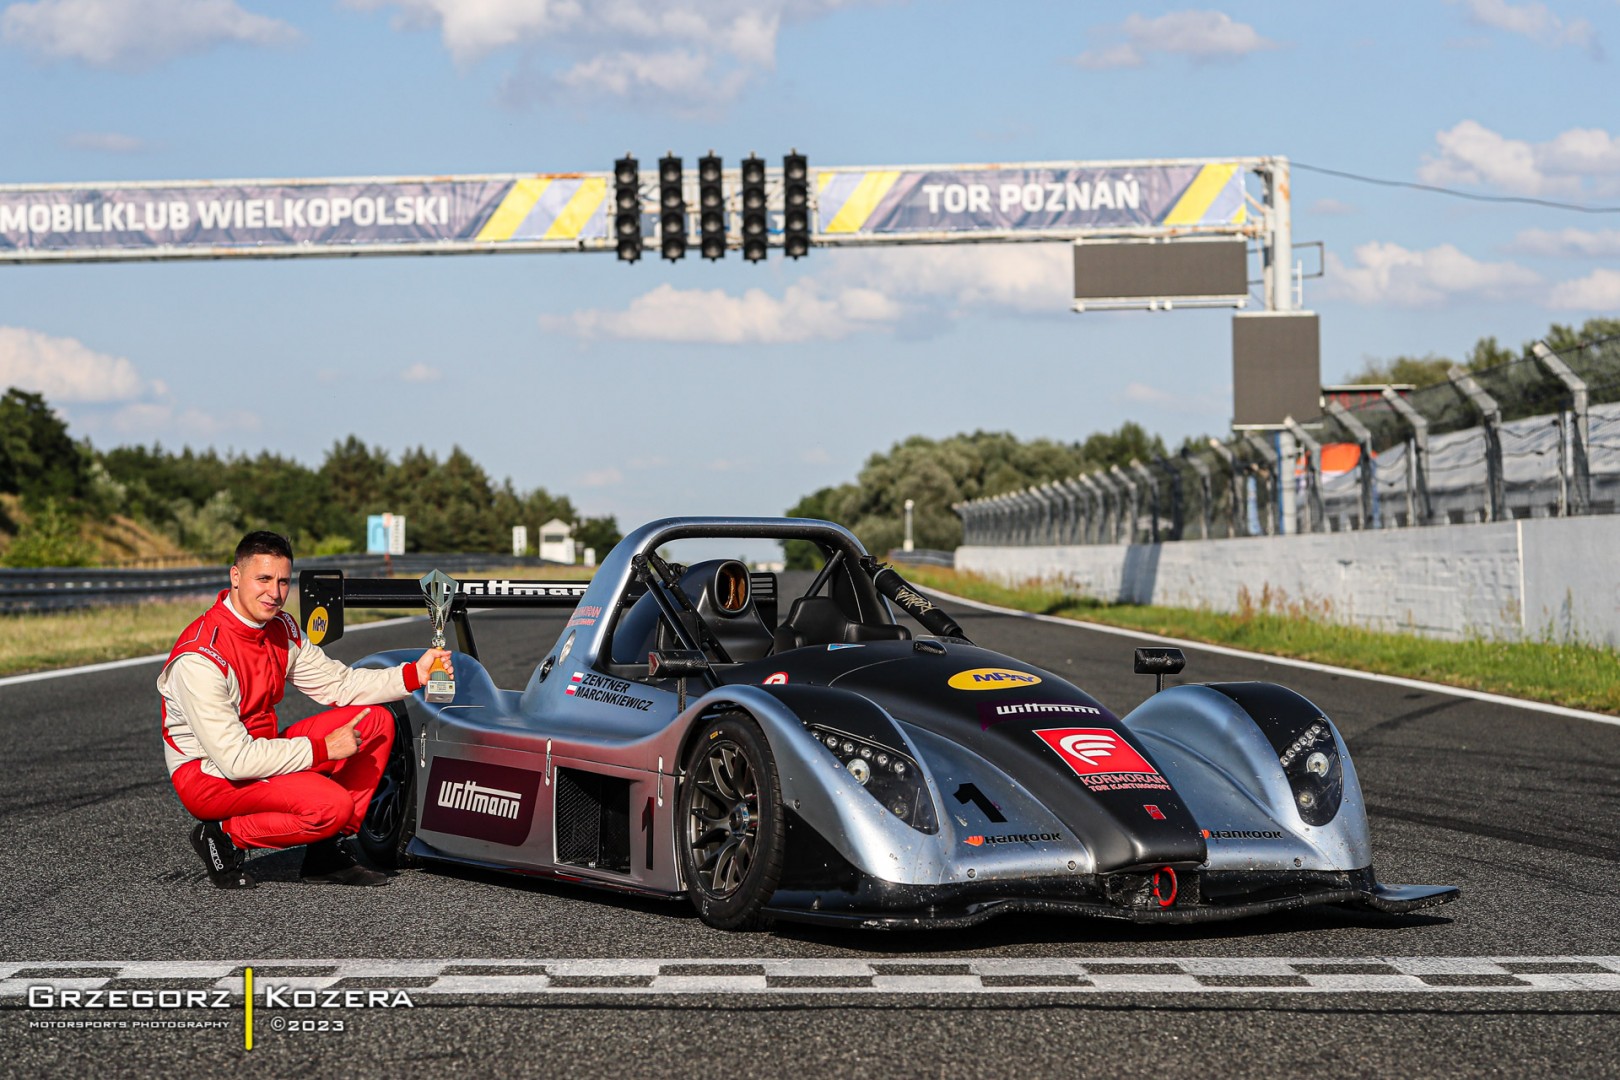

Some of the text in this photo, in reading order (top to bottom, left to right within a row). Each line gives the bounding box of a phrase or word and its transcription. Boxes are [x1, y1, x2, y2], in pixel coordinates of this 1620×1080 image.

[922, 173, 1140, 214] TOR POZNAŃ
[0, 196, 449, 234] MOBILKLUB WIELKOPOLSKI
[575, 686, 654, 711] MARCINKIEWICZ
[582, 673, 631, 693] ZENTNER
[1080, 773, 1168, 786] KORMORAN
[953, 782, 1009, 823] 1
[641, 796, 655, 871] 1
[207, 837, 224, 871] sparco
